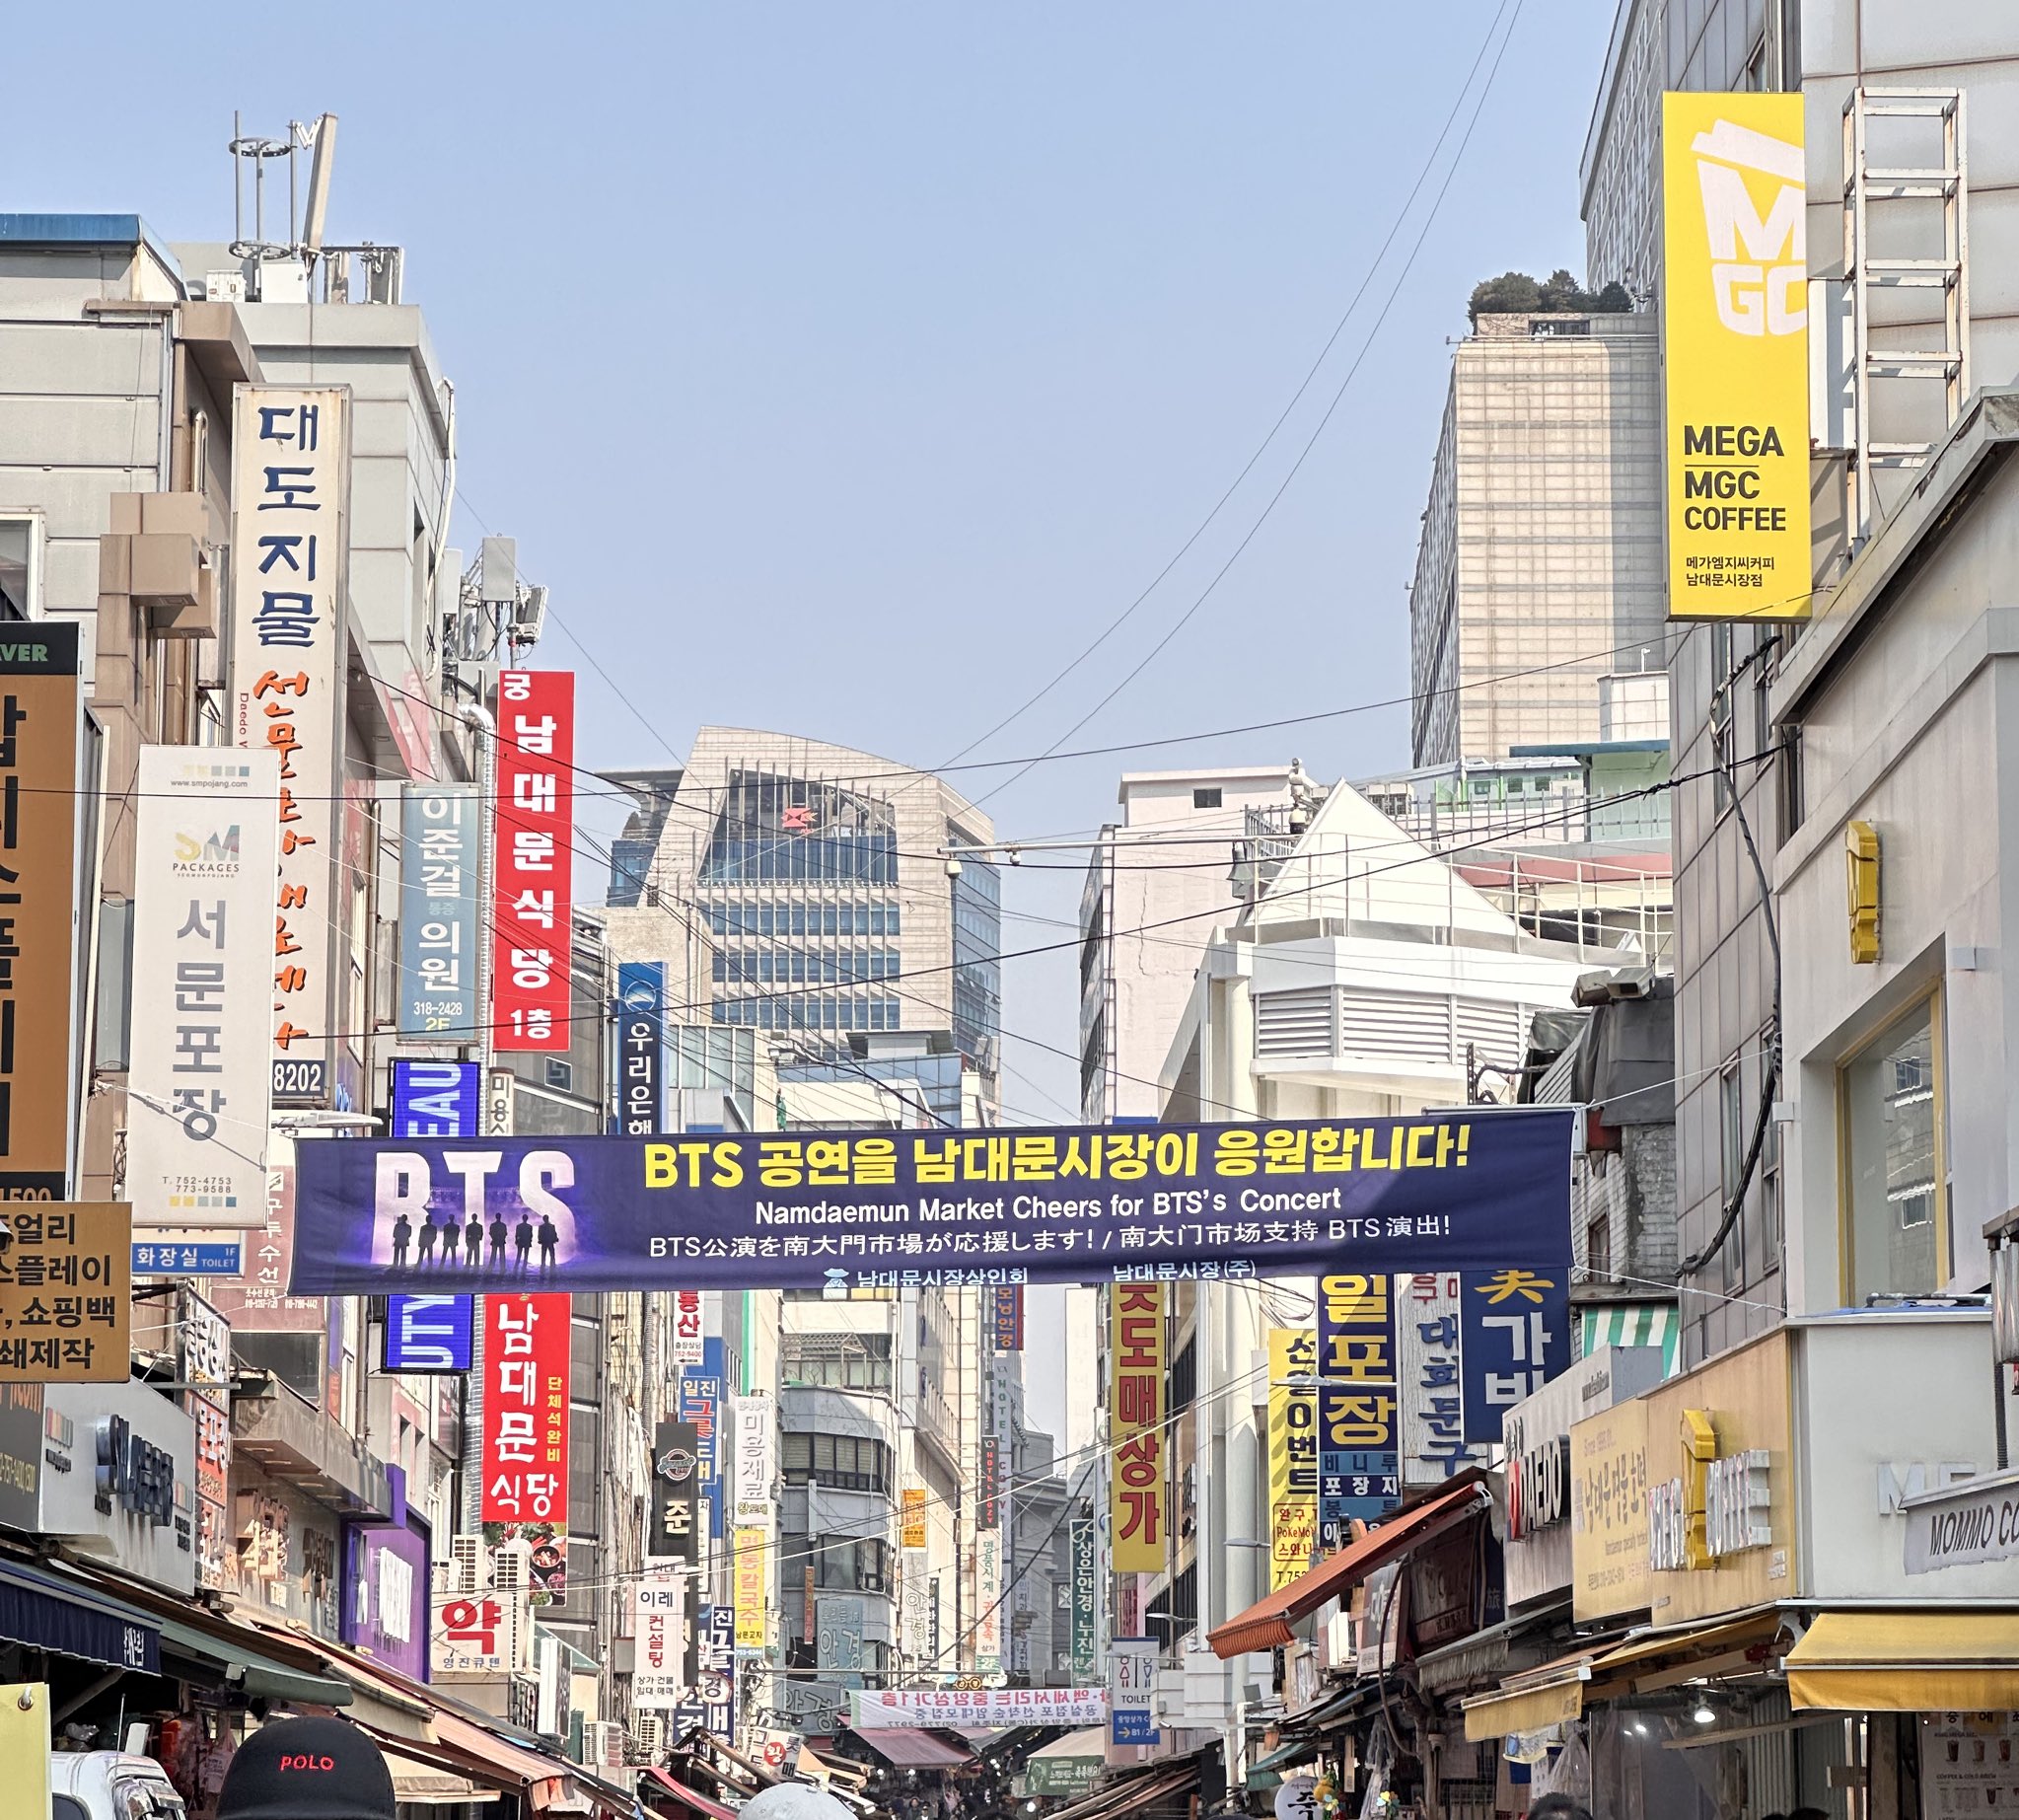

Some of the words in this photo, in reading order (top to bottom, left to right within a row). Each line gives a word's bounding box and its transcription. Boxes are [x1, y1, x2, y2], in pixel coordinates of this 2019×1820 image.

[1685, 425, 1785, 457] MEGA
[1685, 471, 1761, 499] MGC
[252, 403, 322, 648] 대도지물
[1685, 507, 1787, 532] COFFEE
[1686, 556, 1775, 571] 메가엠지씨커피
[1686, 573, 1764, 589] 남대문시장점
[0, 643, 48, 662] VER
[504, 673, 531, 700] 궁
[171, 779, 249, 788] www.smpojang.com
[511, 714, 558, 989] 남대문식당
[173, 863, 240, 873] PACKAGES
[418, 921, 461, 992] 의원
[173, 899, 227, 1141] 서문포장
[413, 1001, 463, 1016] 318-2428
[510, 1008, 552, 1040] 1층
[273, 1062, 322, 1093] 8202
[644, 1142, 744, 1188] BTS
[758, 1137, 899, 1187] 공연을
[913, 1131, 1197, 1184] 남대문시장이
[1213, 1124, 1472, 1178] 응원합니다!
[176, 1185, 232, 1194] 773-9588
[371, 1150, 577, 1267] BTS
[756, 1201, 910, 1225] Namdaemun
[919, 1197, 1004, 1222] Market
[1012, 1195, 1102, 1219] Cheers
[1111, 1193, 1143, 1216] for
[1153, 1190, 1228, 1215] BTS's
[1240, 1187, 1342, 1212] Concert
[0, 1213, 75, 1245] 얼리
[1329, 1216, 1381, 1240] BTS
[137, 1247, 197, 1268] 화장실
[201, 1259, 235, 1268] TOILET
[857, 1268, 1029, 1287] 남대문시장상인회
[1113, 1259, 1257, 1282] 남대문시장(주)
[20, 1296, 115, 1328] 쇼핑백
[494, 1302, 540, 1463] 남대문
[683, 1380, 716, 1397] 일진
[546, 1376, 563, 1463] 단체석완비
[490, 1473, 559, 1517] 식당
[1324, 1477, 1398, 1496] 포장지
[1929, 1504, 1994, 1557] MOMMO
[640, 1591, 674, 1608] 이레
[441, 1597, 502, 1655] 약
[648, 1615, 664, 1669] 컨설팅
[1121, 1695, 1151, 1705] TOILET
[280, 1755, 334, 1772] POLO
